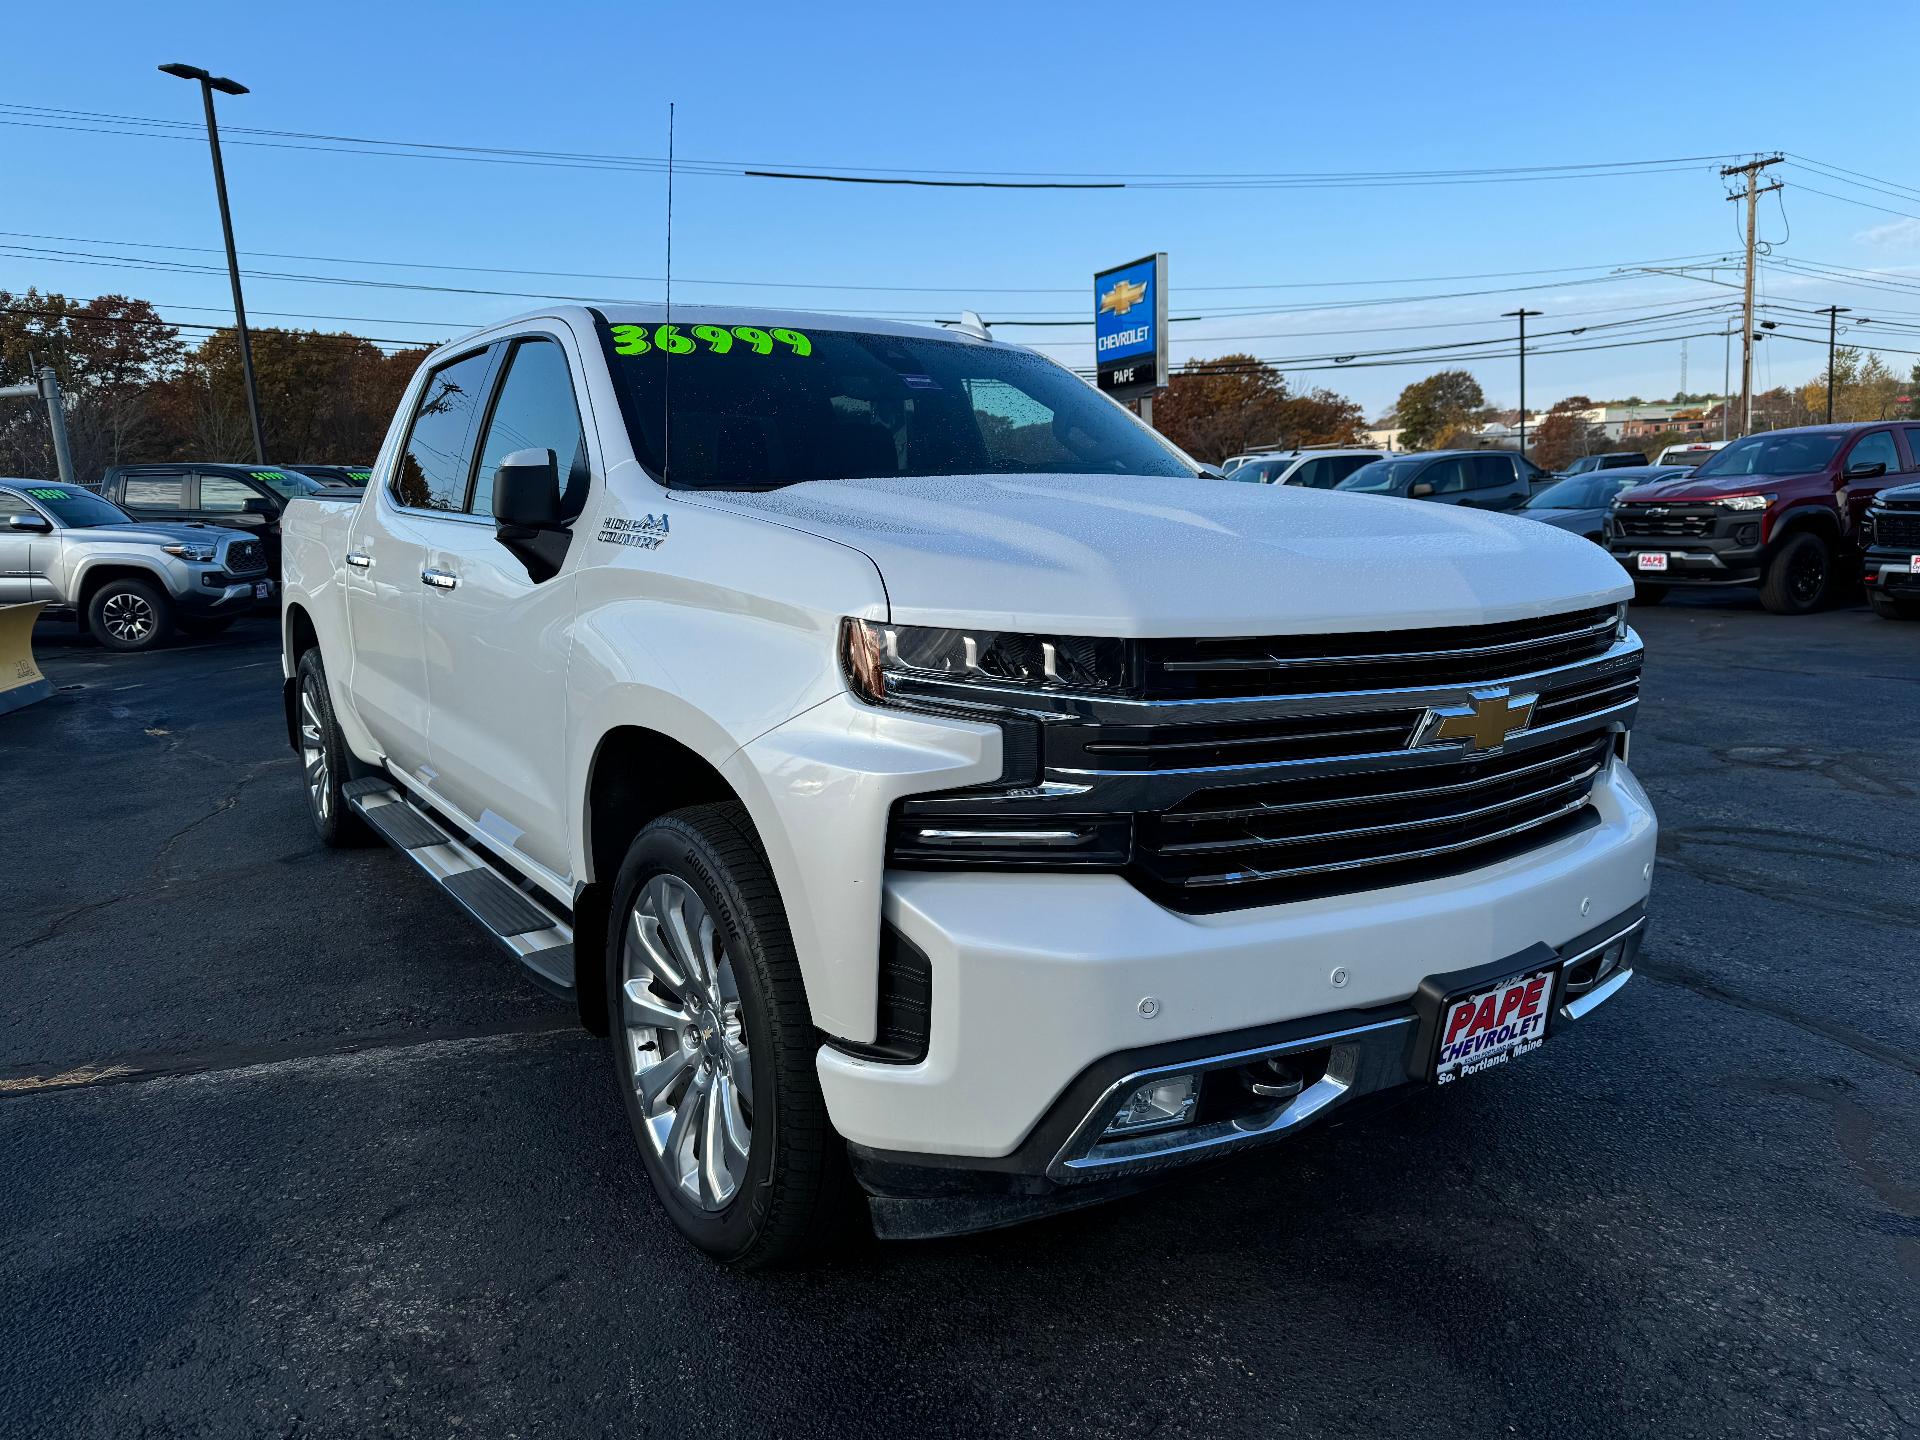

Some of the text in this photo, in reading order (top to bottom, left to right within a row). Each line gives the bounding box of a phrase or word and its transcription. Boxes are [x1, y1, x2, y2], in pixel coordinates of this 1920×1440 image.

[610, 324, 812, 357] 36999
[1098, 325, 1150, 352] CHEVROLET
[1113, 367, 1135, 385] PAPE
[602, 517, 635, 531] HIGH
[597, 530, 665, 550] COUNTRY
[1641, 555, 1665, 564] PAPE
[684, 847, 742, 944] BRIDGESTONE
[1444, 976, 1547, 1045] PAPE
[1438, 1012, 1543, 1065] CHEVROLET
[1437, 1038, 1543, 1085] So. Portland, Maine
